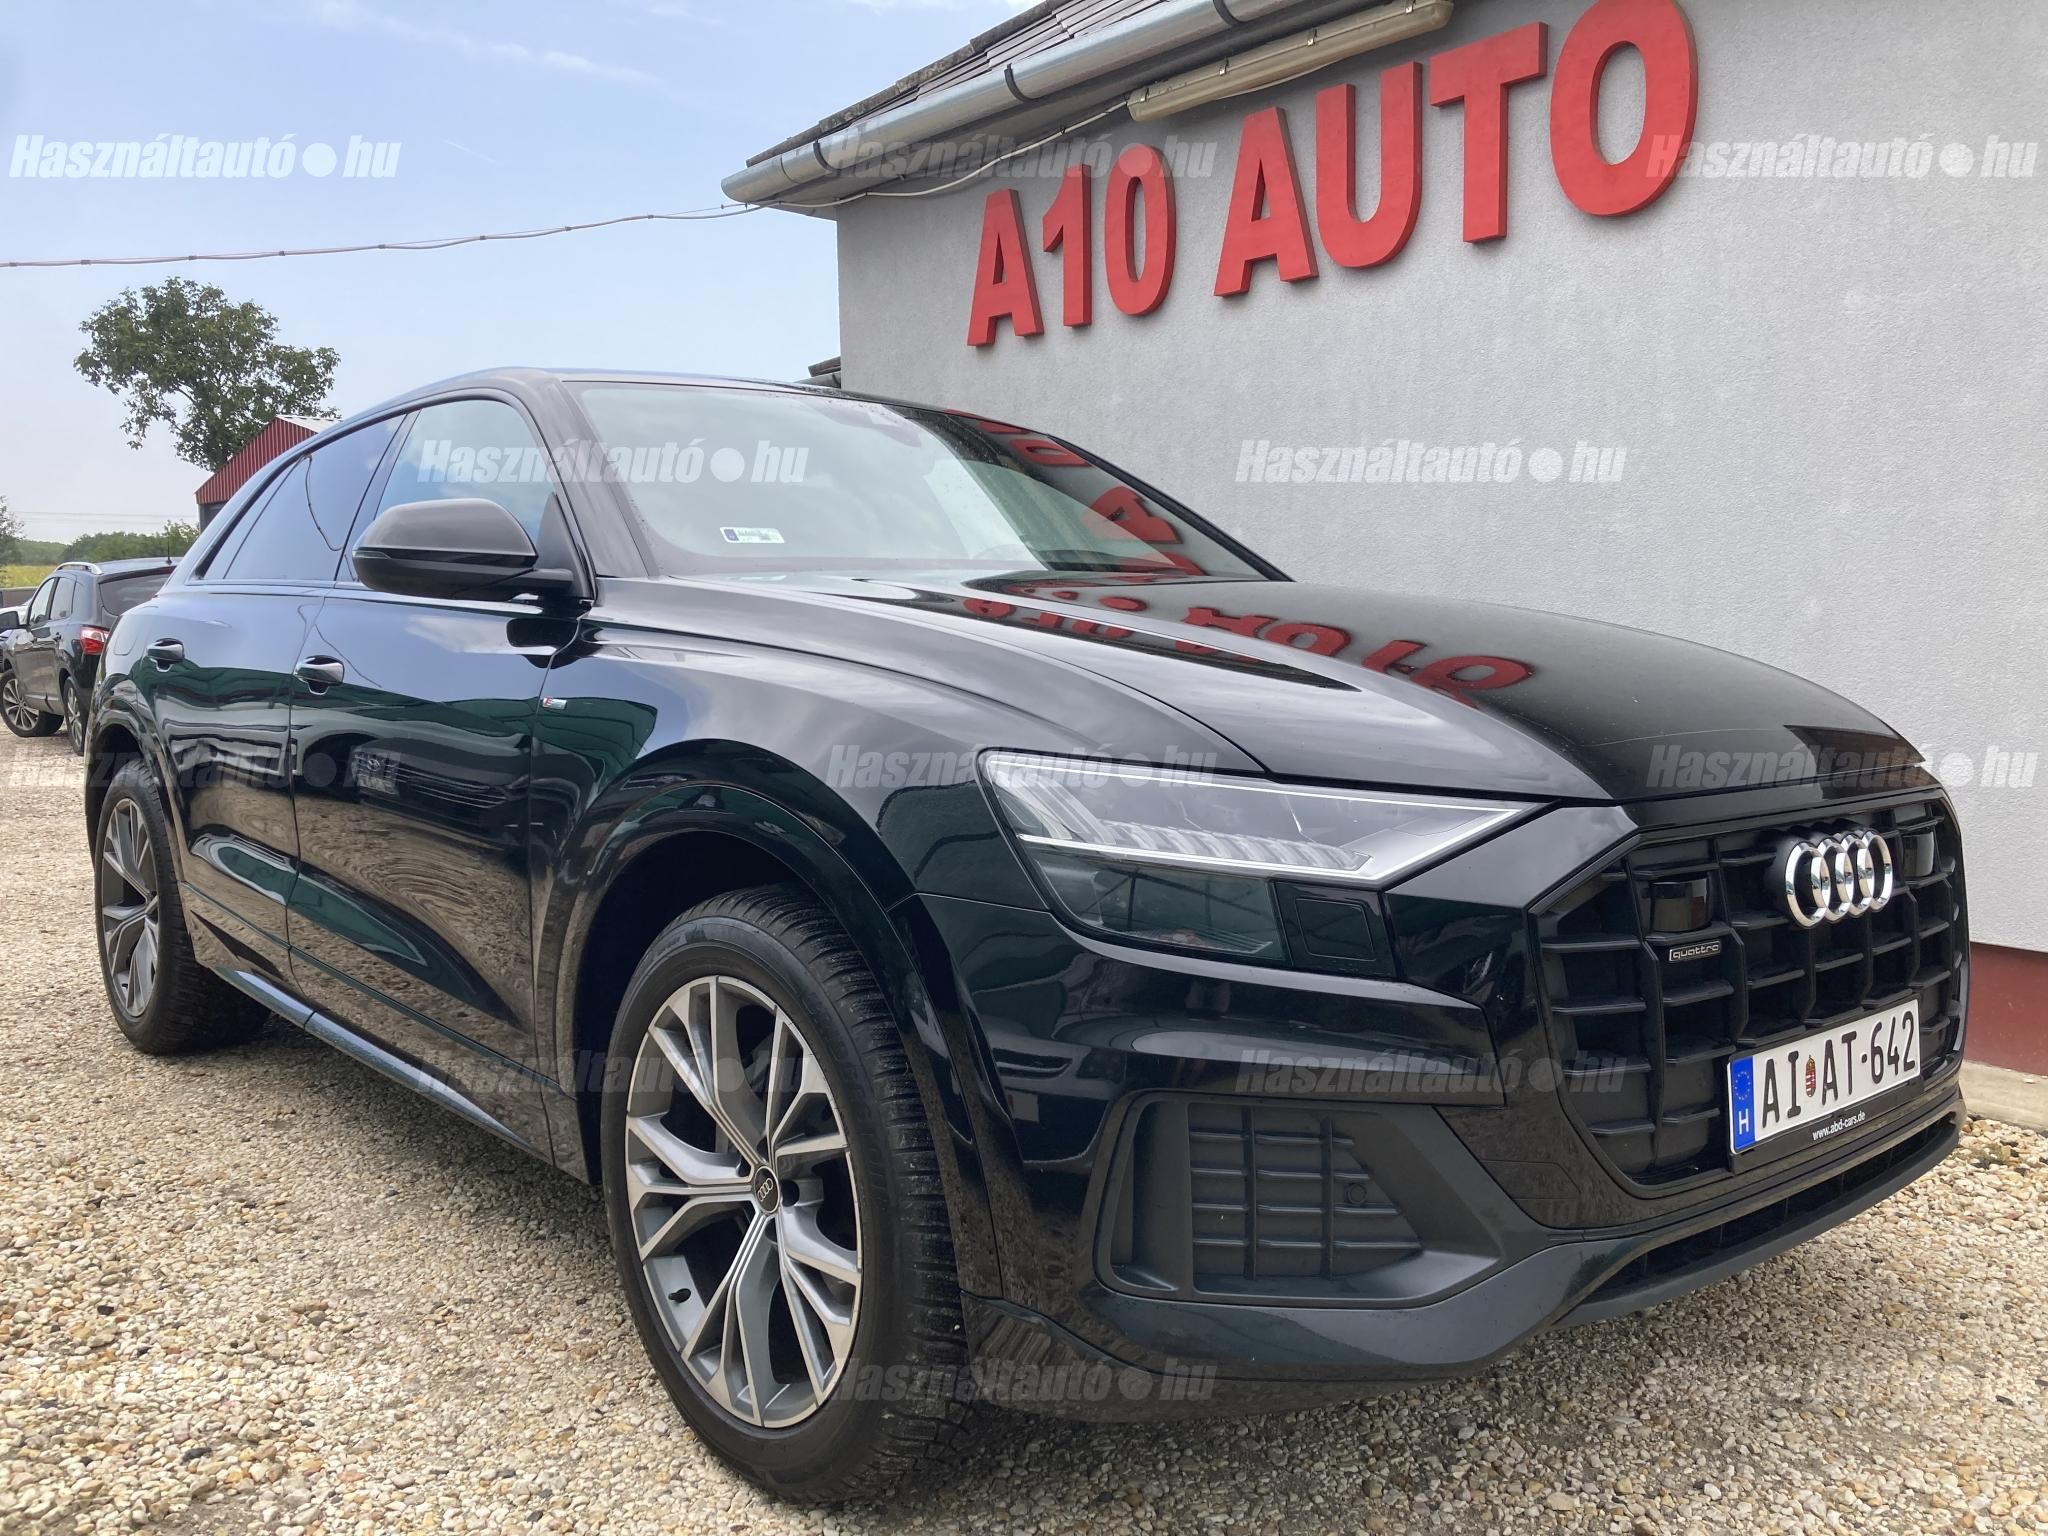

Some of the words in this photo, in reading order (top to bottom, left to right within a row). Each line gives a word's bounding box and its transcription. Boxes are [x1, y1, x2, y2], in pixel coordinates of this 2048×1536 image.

[966, 144, 1177, 347] A10
[1213, 0, 1699, 299] AUTO
[1672, 943, 1720, 960] quattro
[1762, 1050, 1802, 1129] AI
[1738, 1108, 1750, 1136] H
[1812, 1110, 1867, 1141] www.abd-cars.de
